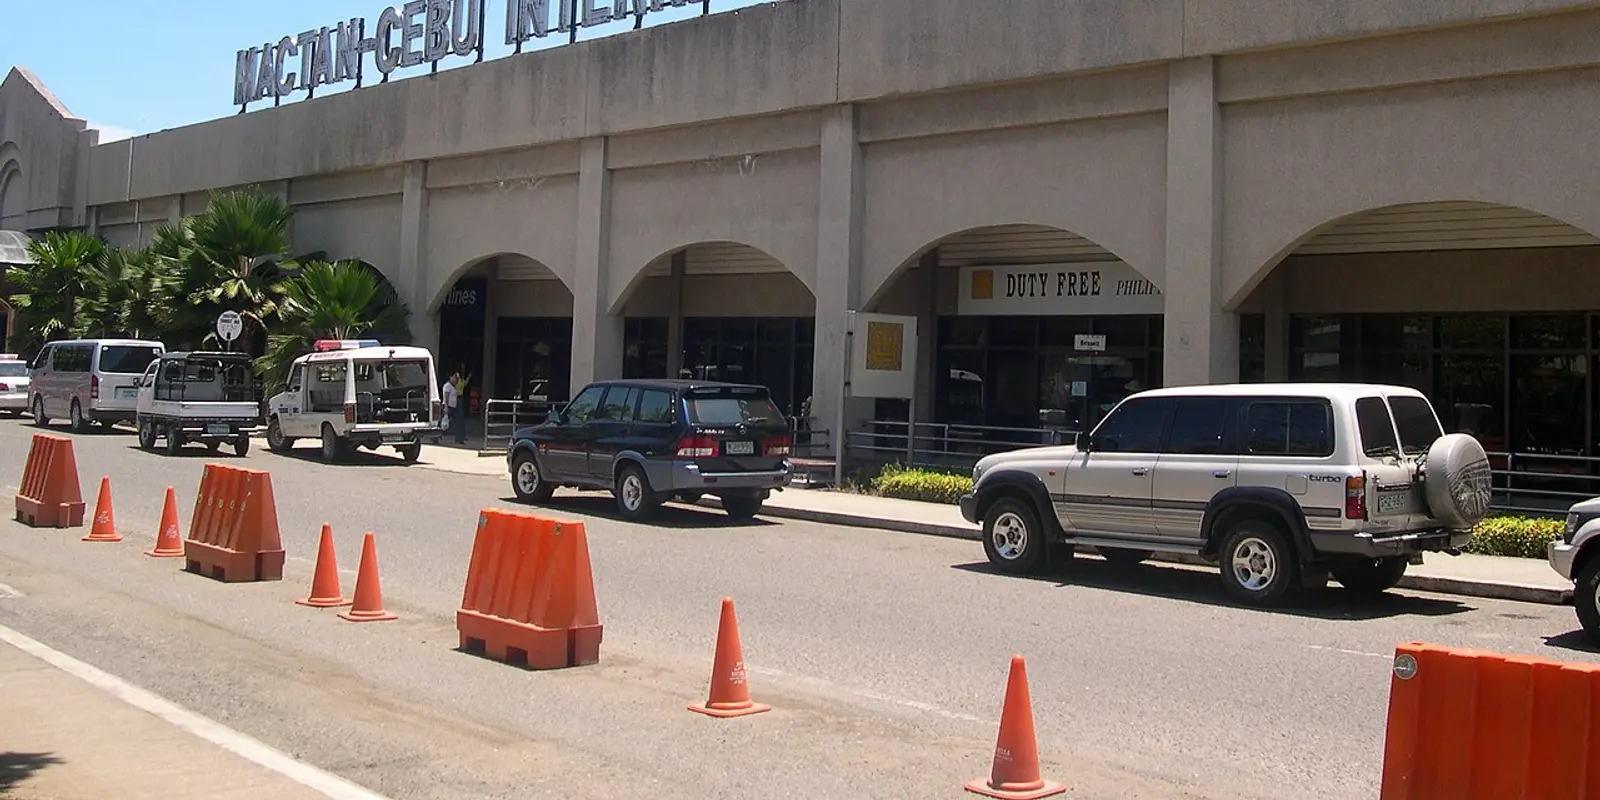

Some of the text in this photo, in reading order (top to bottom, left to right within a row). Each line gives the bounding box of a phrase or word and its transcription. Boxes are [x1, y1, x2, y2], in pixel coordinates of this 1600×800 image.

[1006, 272, 1048, 297] DUTY
[1056, 271, 1101, 296] FREE
[1309, 474, 1341, 483] turbo
